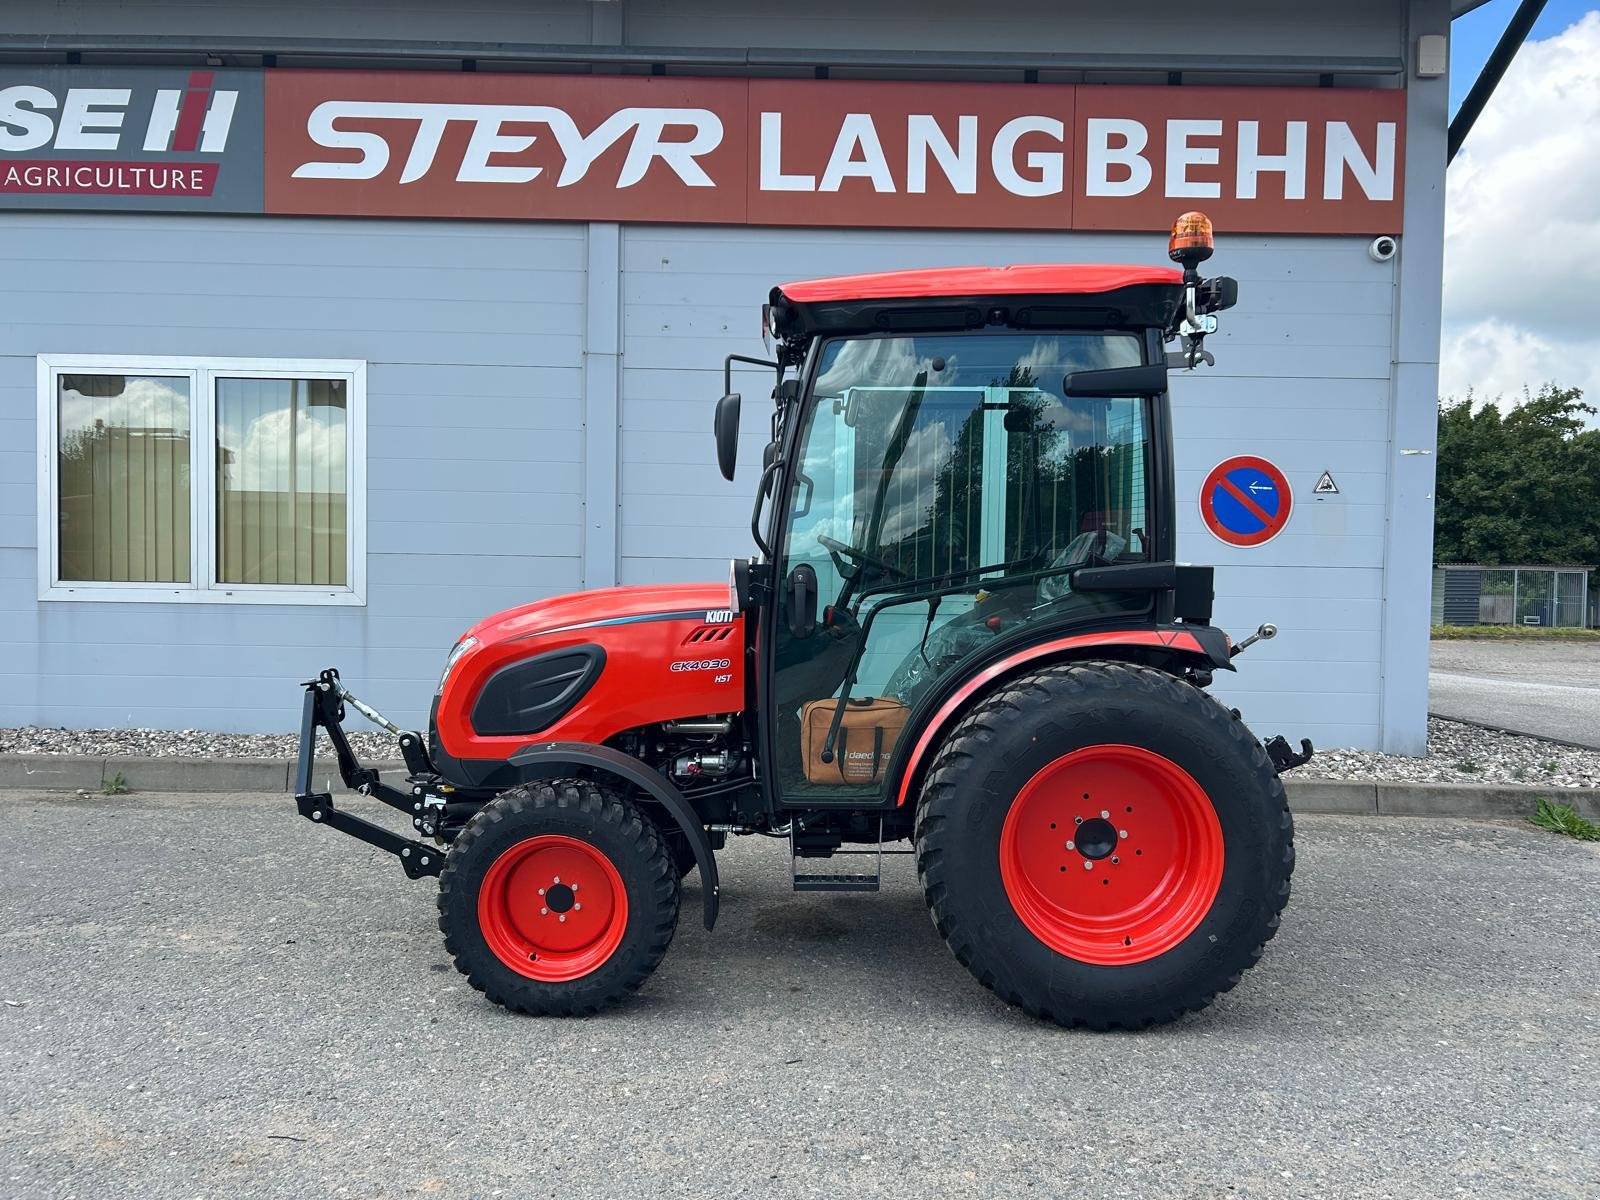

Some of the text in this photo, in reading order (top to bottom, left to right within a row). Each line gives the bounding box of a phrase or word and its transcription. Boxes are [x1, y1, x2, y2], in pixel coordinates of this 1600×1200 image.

[291, 100, 1397, 201] STEYR LANGBEHN
[4, 166, 204, 190] AGRICULTURE
[705, 611, 733, 622] KIOTI
[670, 659, 730, 672] CK4030
[714, 675, 732, 683] HST
